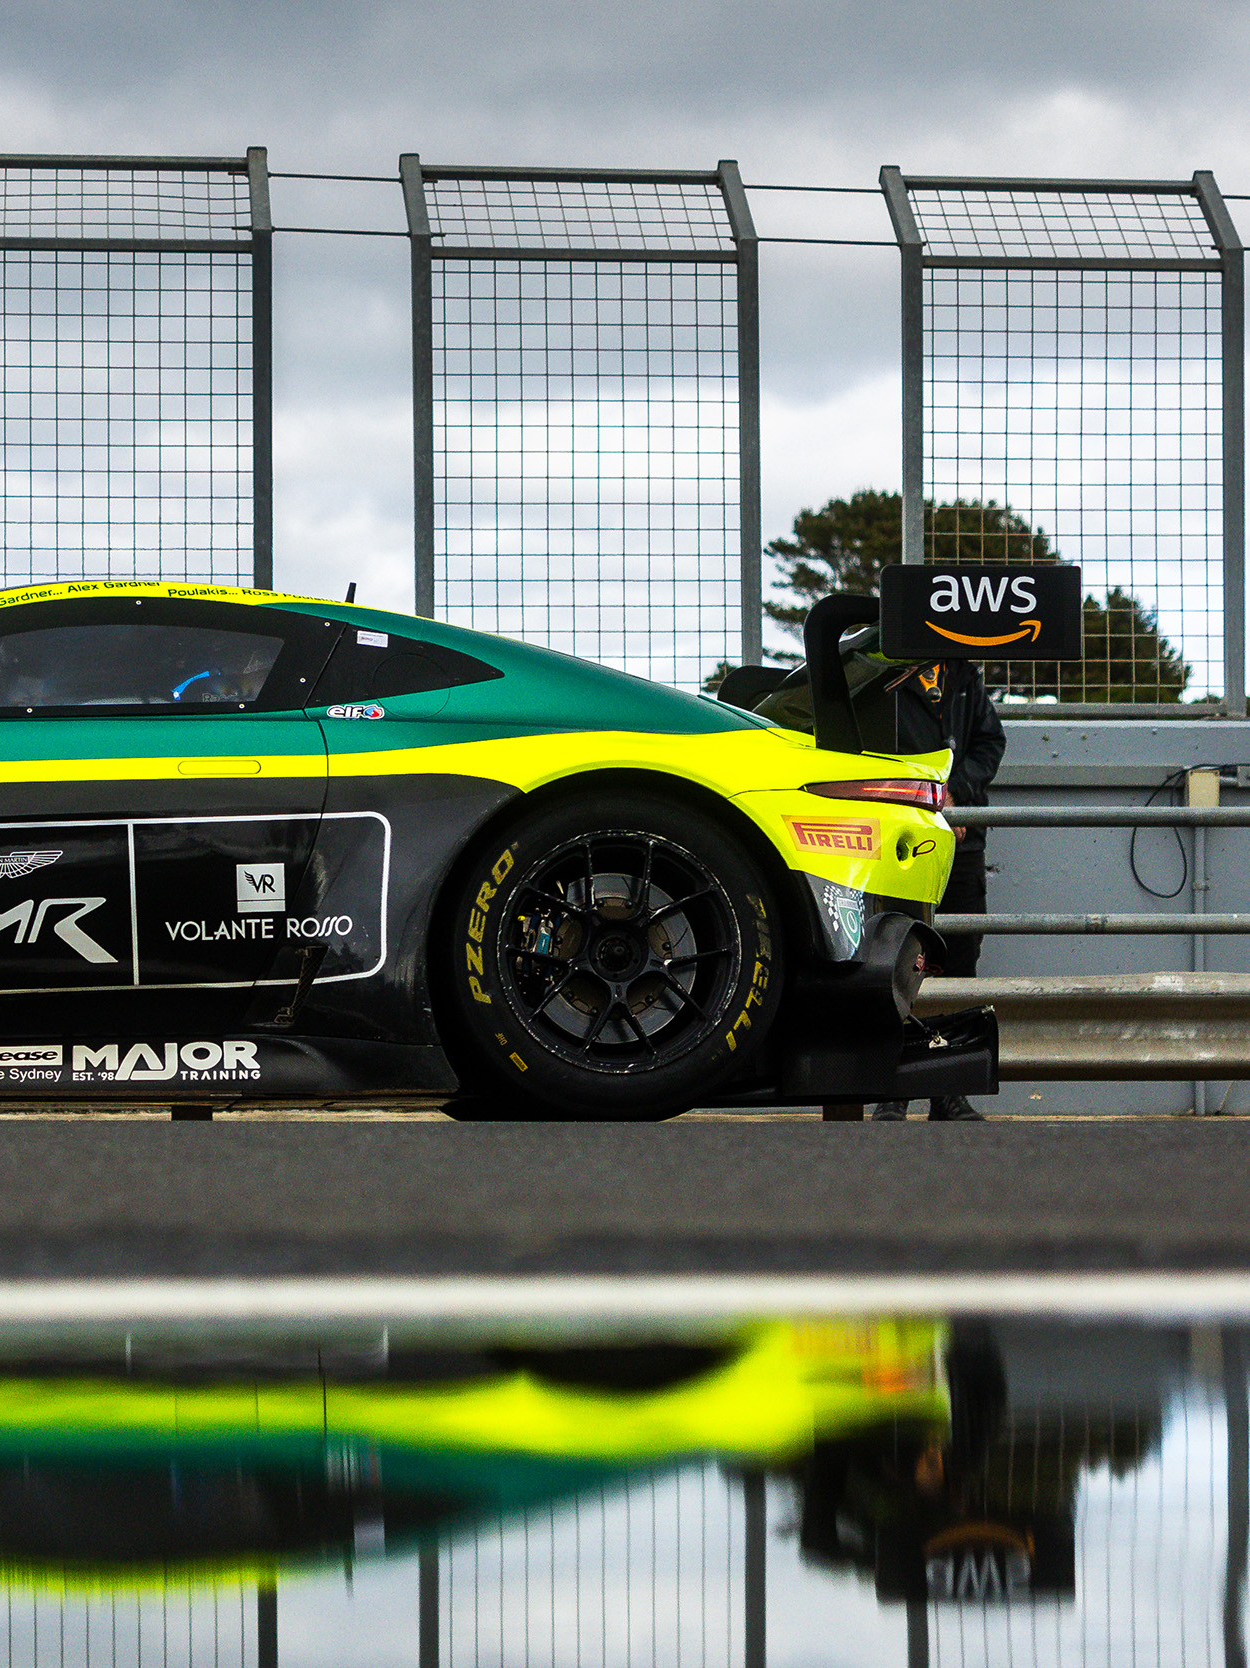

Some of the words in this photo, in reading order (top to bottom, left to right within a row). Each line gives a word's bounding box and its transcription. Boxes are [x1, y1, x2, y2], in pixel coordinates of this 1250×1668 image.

[68, 584, 99, 593] Alex
[242, 589, 279, 597] Ross
[929, 575, 1037, 614] aws
[791, 821, 873, 852] PIRELLI
[3, 856, 29, 864] MARTIN
[165, 918, 274, 941] VOLANTE
[286, 915, 353, 938] ROSSO
[72, 1041, 261, 1080] MAJOR
[9, 1068, 62, 1082] Sydney
[72, 1072, 95, 1081] EST.
[180, 1070, 261, 1081] TRAINING
